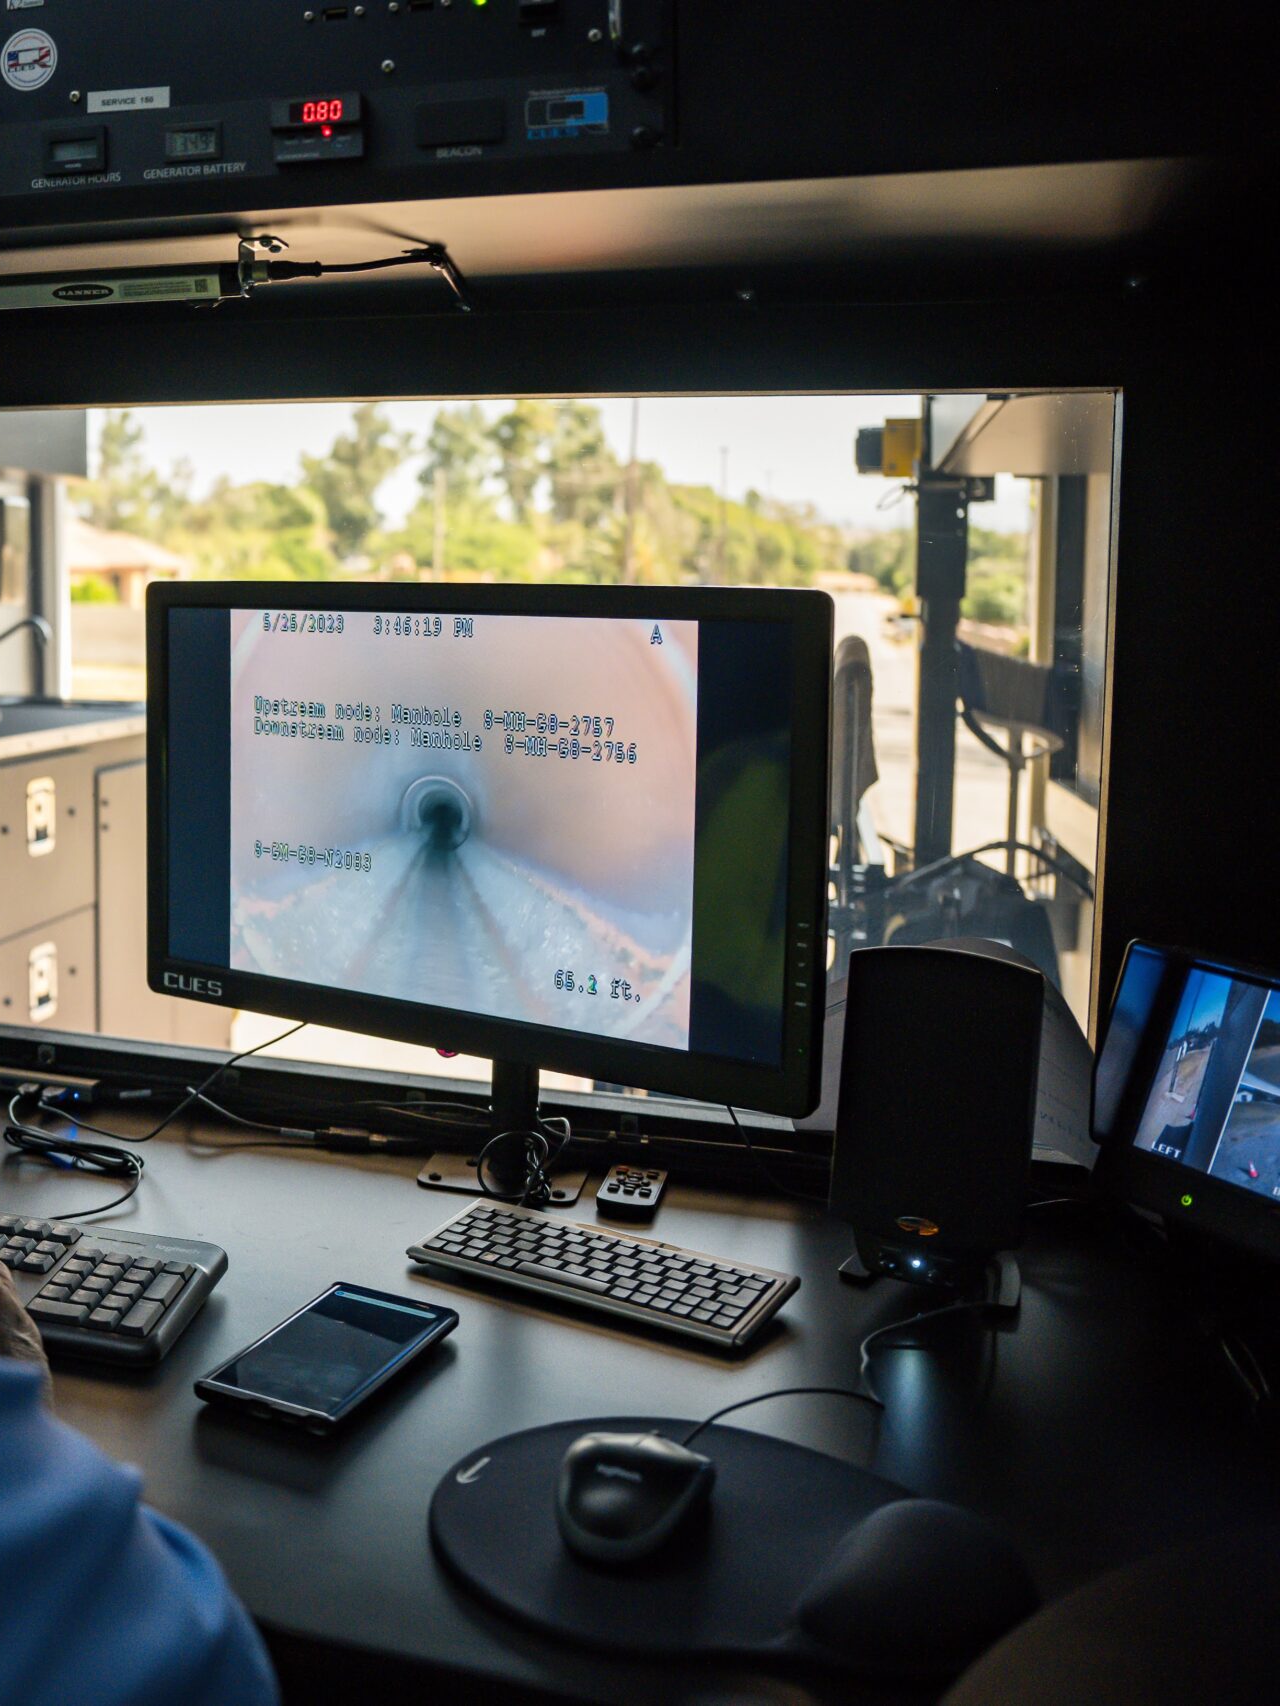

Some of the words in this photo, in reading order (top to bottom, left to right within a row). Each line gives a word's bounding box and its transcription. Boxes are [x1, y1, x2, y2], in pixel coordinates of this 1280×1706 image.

[101, 98, 136, 107] SERVICE
[436, 146, 483, 158] BEACON
[31, 174, 86, 189] GENERATOR
[88, 172, 121, 185] HOURS
[143, 166, 201, 180] GENERATOR
[203, 162, 247, 176] BATTERY
[58, 288, 110, 298] BANNER
[262, 612, 345, 633] 5/25/2023
[373, 615, 443, 636] 3:46:19
[453, 617, 474, 638] PM
[650, 623, 663, 645] A
[253, 695, 326, 719] Upstream
[335, 701, 381, 722] node:
[390, 704, 462, 727] Manhole
[483, 709, 615, 737] S-MH-G8-2757
[253, 715, 345, 742] Downstream
[353, 724, 401, 746] node:
[410, 727, 483, 752] Manhole
[503, 733, 638, 764] S-MH-G8-2756
[163, 971, 223, 997] CUES
[610, 977, 641, 1003] ft.
[1151, 1141, 1182, 1159] LEFT
